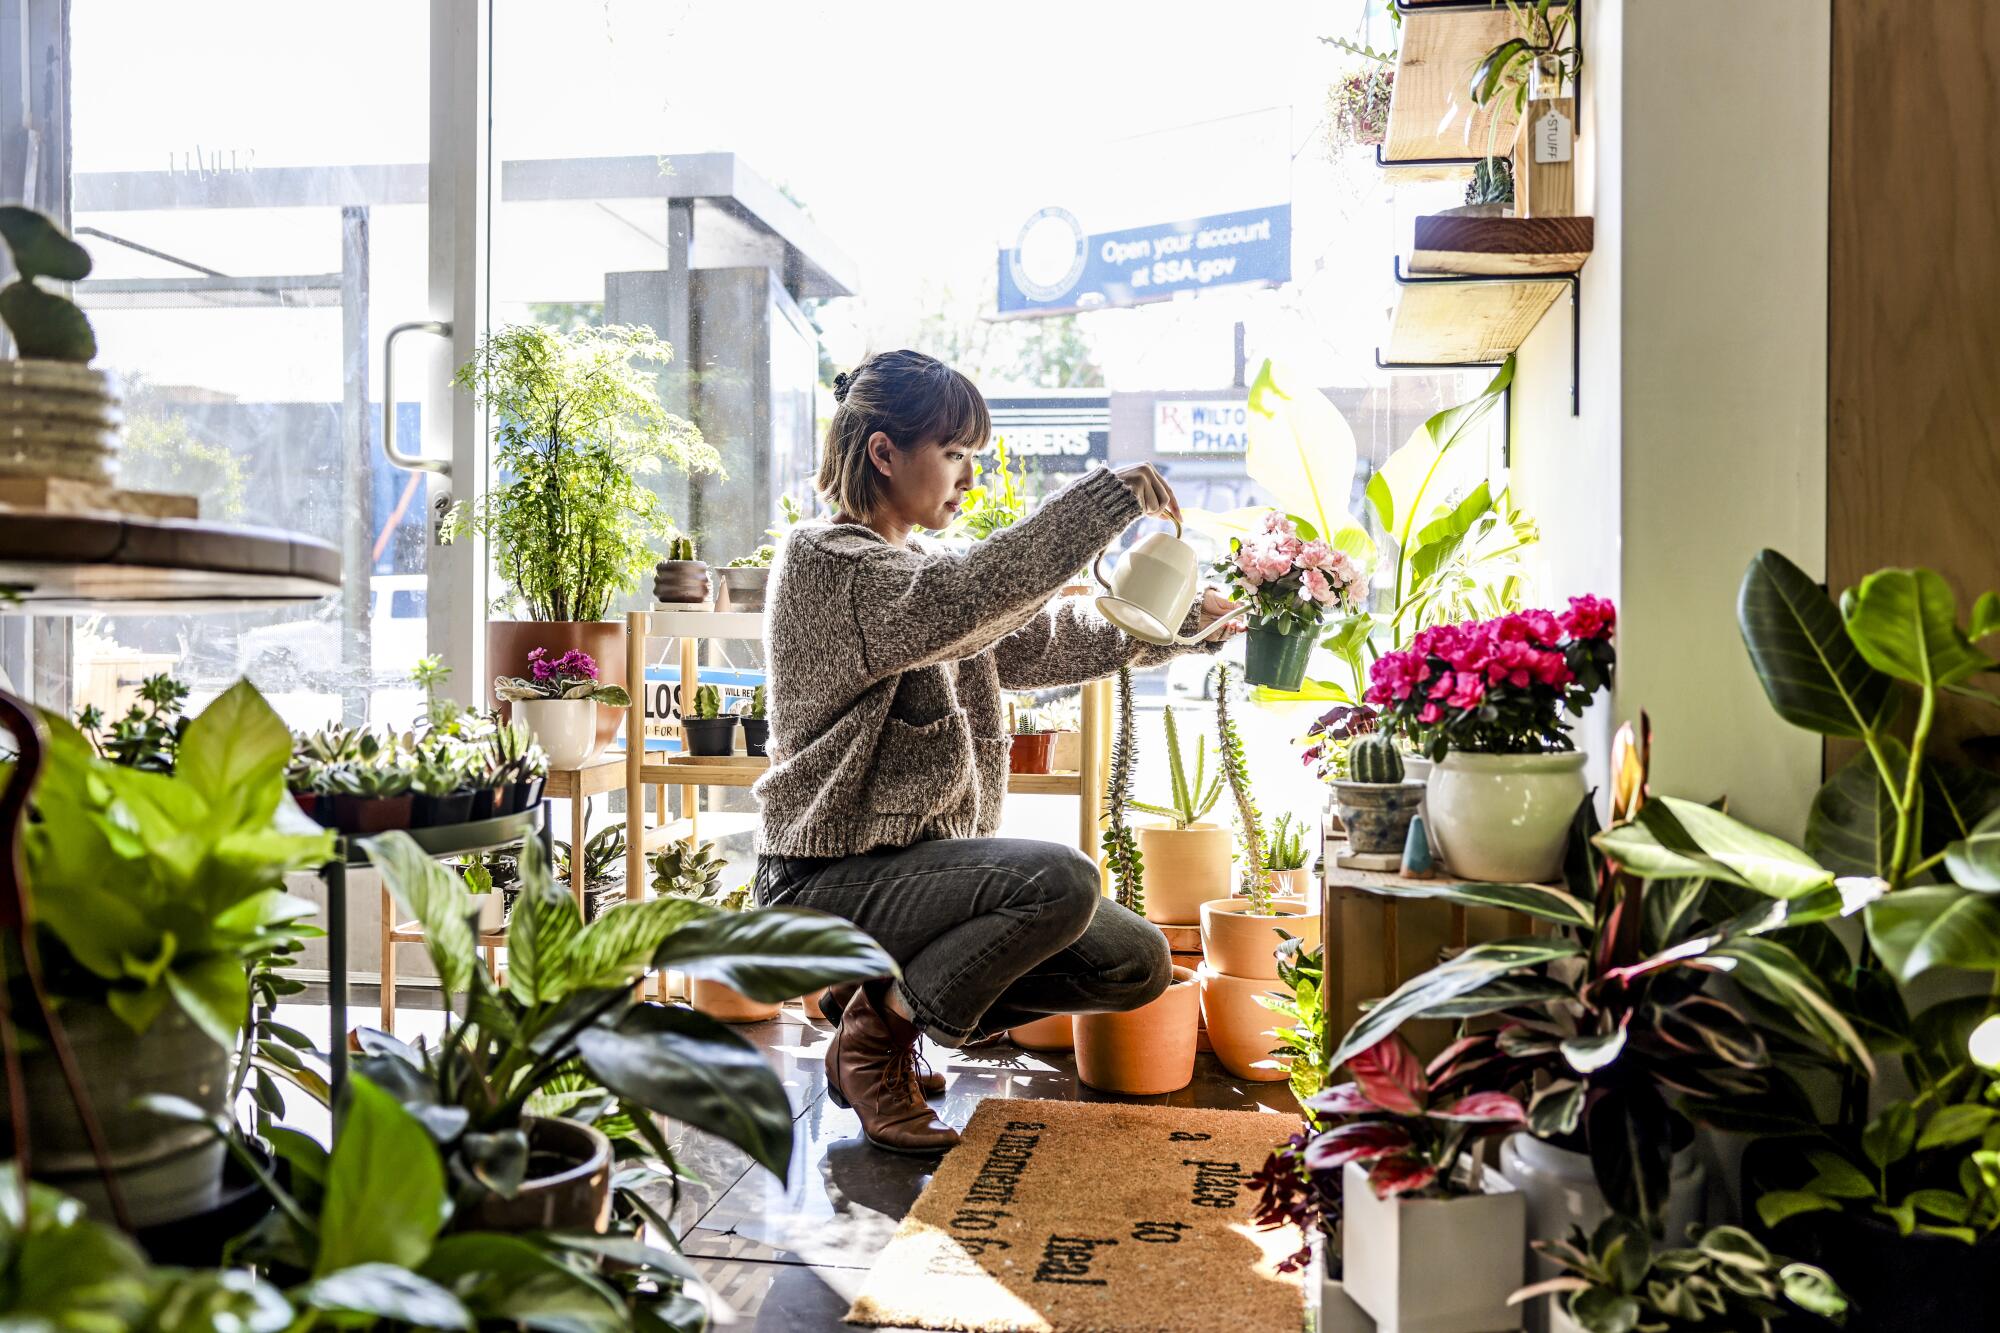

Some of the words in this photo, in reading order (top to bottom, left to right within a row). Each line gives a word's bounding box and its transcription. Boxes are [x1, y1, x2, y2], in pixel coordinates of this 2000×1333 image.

[1101, 240, 1150, 265] Open
[1153, 233, 1193, 260] your
[1195, 219, 1271, 250] account
[1131, 267, 1149, 288] at
[1152, 257, 1236, 283] SSA.gov
[1192, 406, 1246, 425] WILTO
[983, 431, 1090, 455] ARBERS
[1193, 429, 1248, 448] PHA
[645, 683, 681, 719] LOS
[725, 687, 741, 697] WILL
[742, 689, 754, 698] RET
[654, 726, 673, 737] FOR
[1004, 1121, 1046, 1132] a
[1168, 1131, 1212, 1143] a
[963, 1131, 1039, 1206] moment
[1182, 1158, 1254, 1209] place
[949, 1208, 1013, 1231] to
[1130, 1220, 1193, 1245] to
[1033, 1233, 1119, 1287] heal
